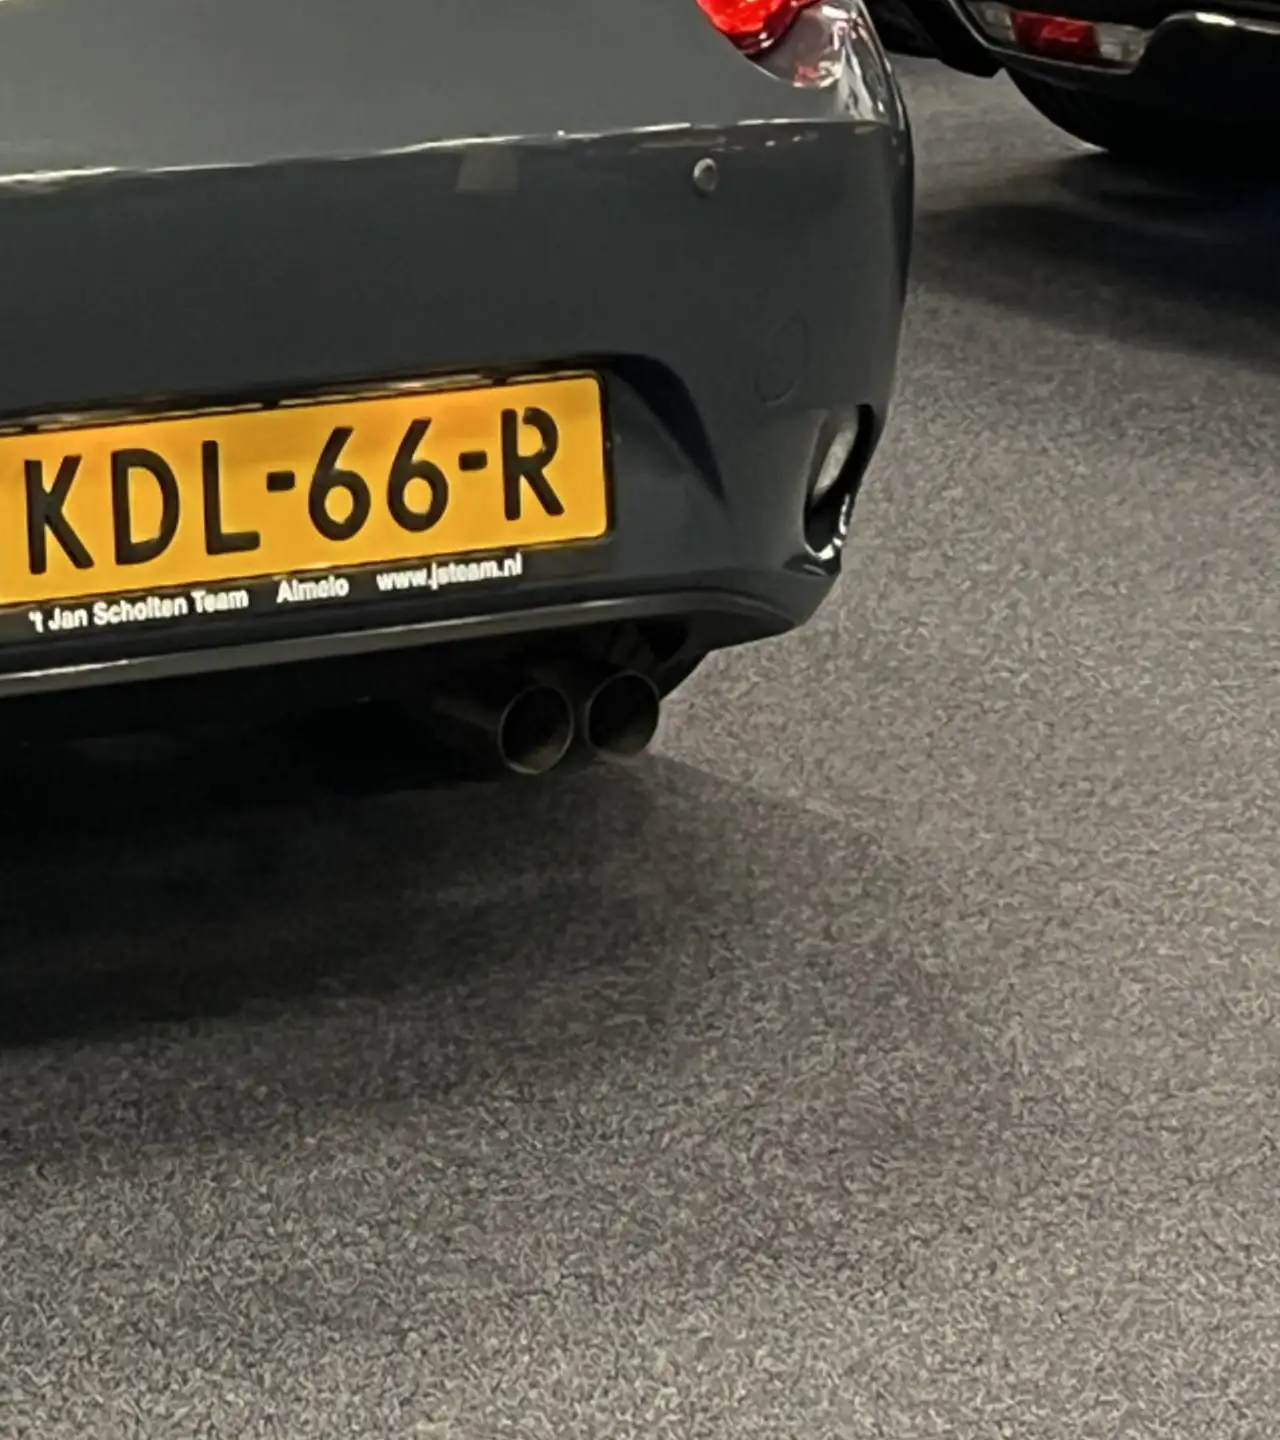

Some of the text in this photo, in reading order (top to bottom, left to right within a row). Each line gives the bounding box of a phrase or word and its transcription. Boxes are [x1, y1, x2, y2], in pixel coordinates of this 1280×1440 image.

[23, 407, 566, 576] KDL-66-R
[48, 607, 90, 631] Jan
[93, 595, 189, 626] Scholten
[191, 589, 250, 613] Team
[276, 575, 350, 604] Almelo
[376, 551, 524, 592] www.jsteam.nl
